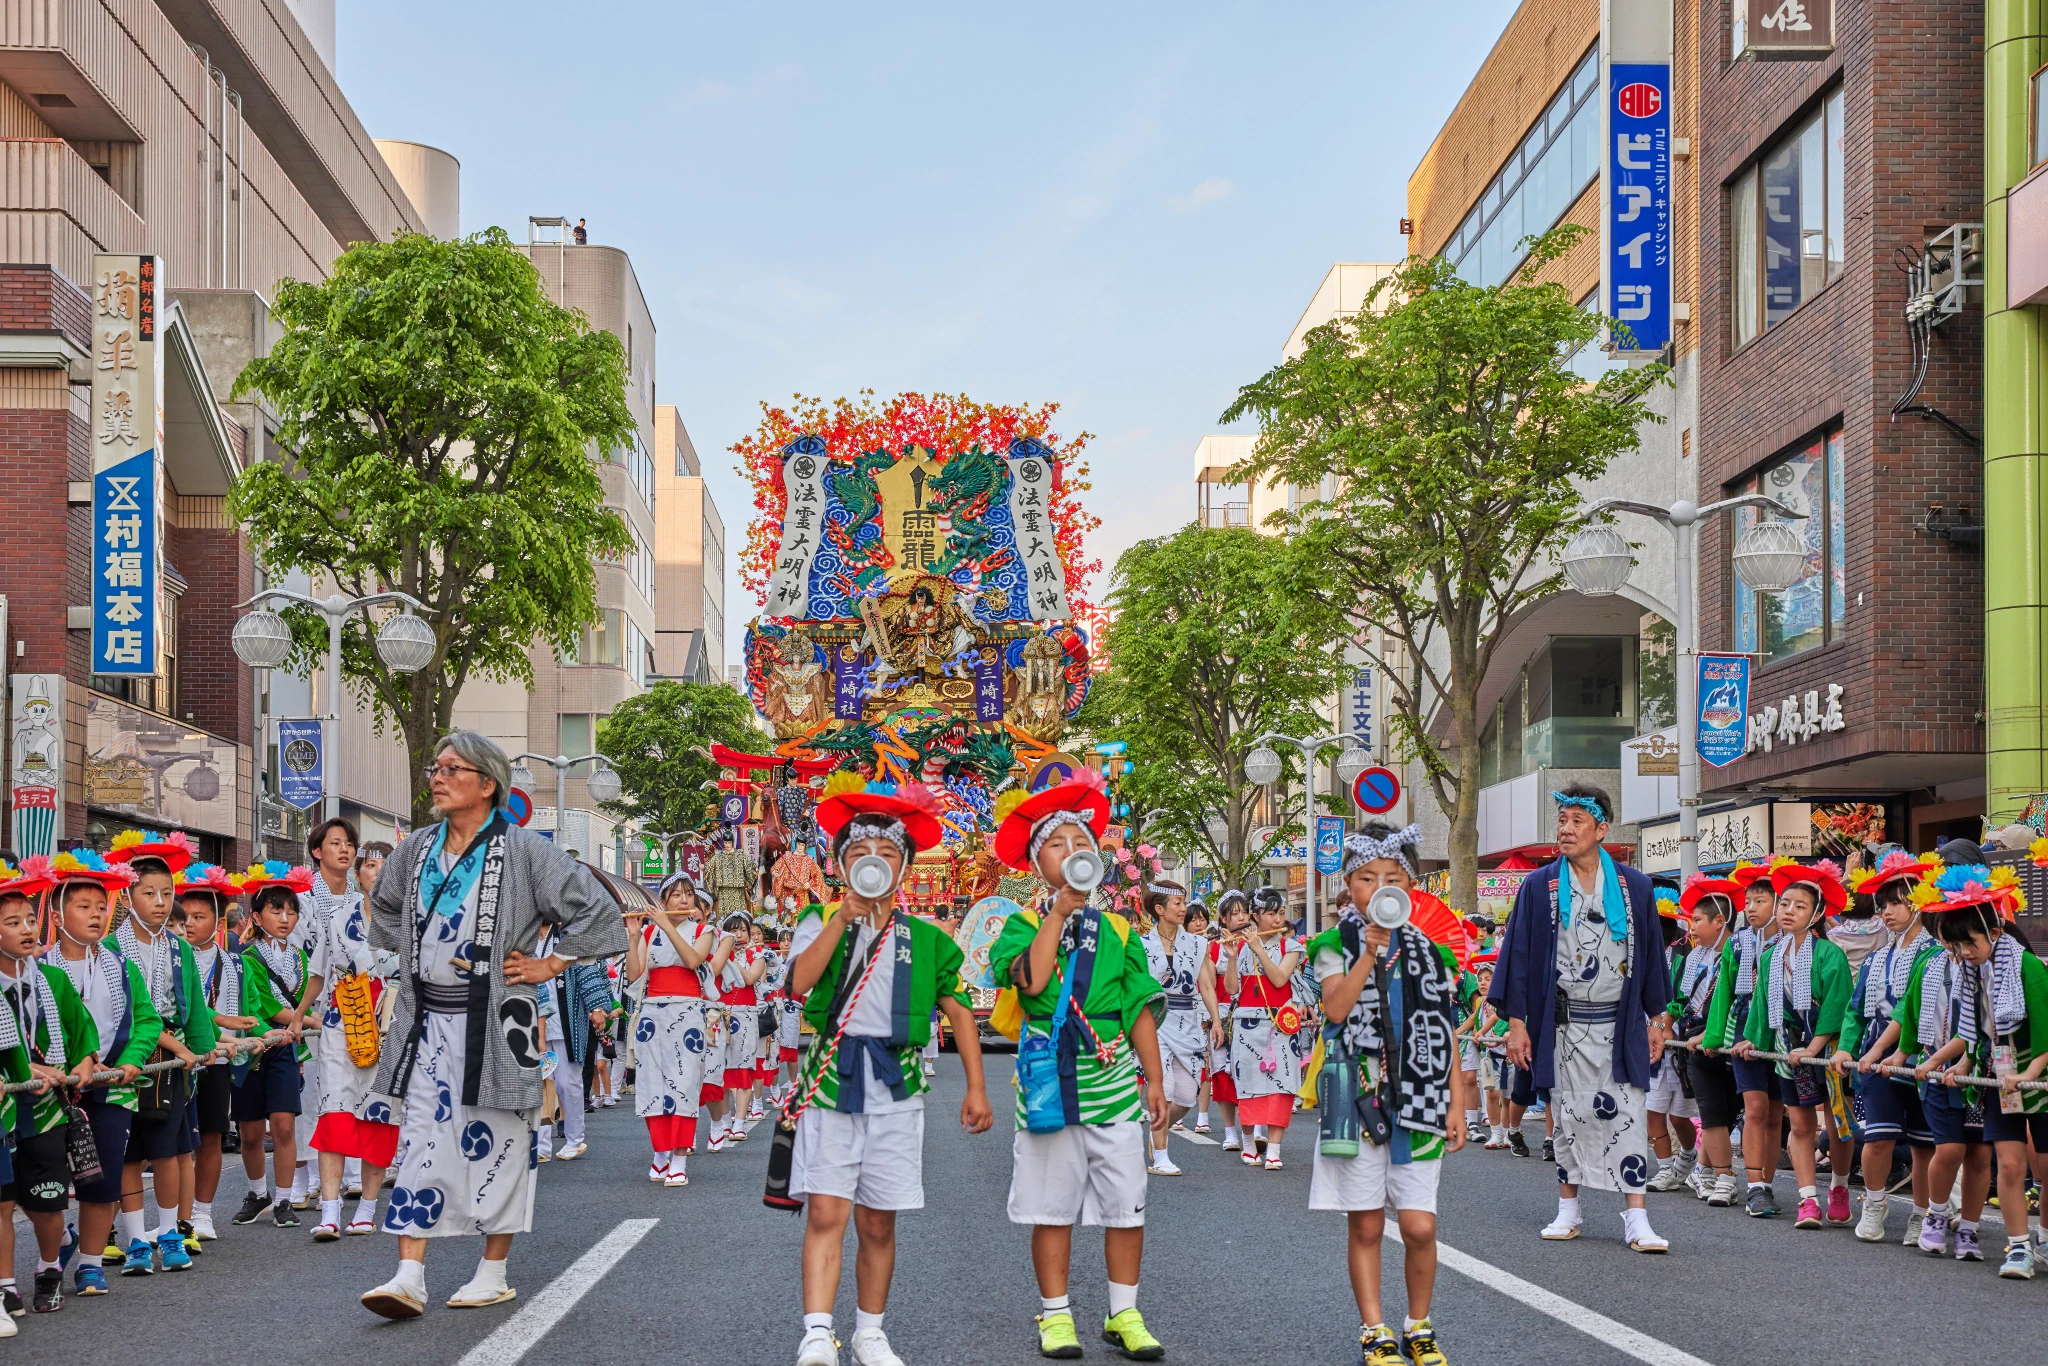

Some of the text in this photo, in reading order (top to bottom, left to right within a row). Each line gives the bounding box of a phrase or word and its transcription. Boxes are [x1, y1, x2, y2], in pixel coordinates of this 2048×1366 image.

[1620, 84, 1660, 117] BIG
[1655, 128, 1666, 266] コミュニティ キャッシング
[140, 261, 154, 335] 南部名産
[97, 270, 139, 446] 菊羊羹
[104, 514, 142, 664] 村福本店
[20, 793, 50, 805] 生デコ
[1478, 888, 1513, 897] TAPIOCA
[170, 937, 183, 967] 内丸
[895, 923, 912, 964] 内丸
[1079, 918, 1098, 953] 内丸
[1416, 1022, 1429, 1063] ROUTE
